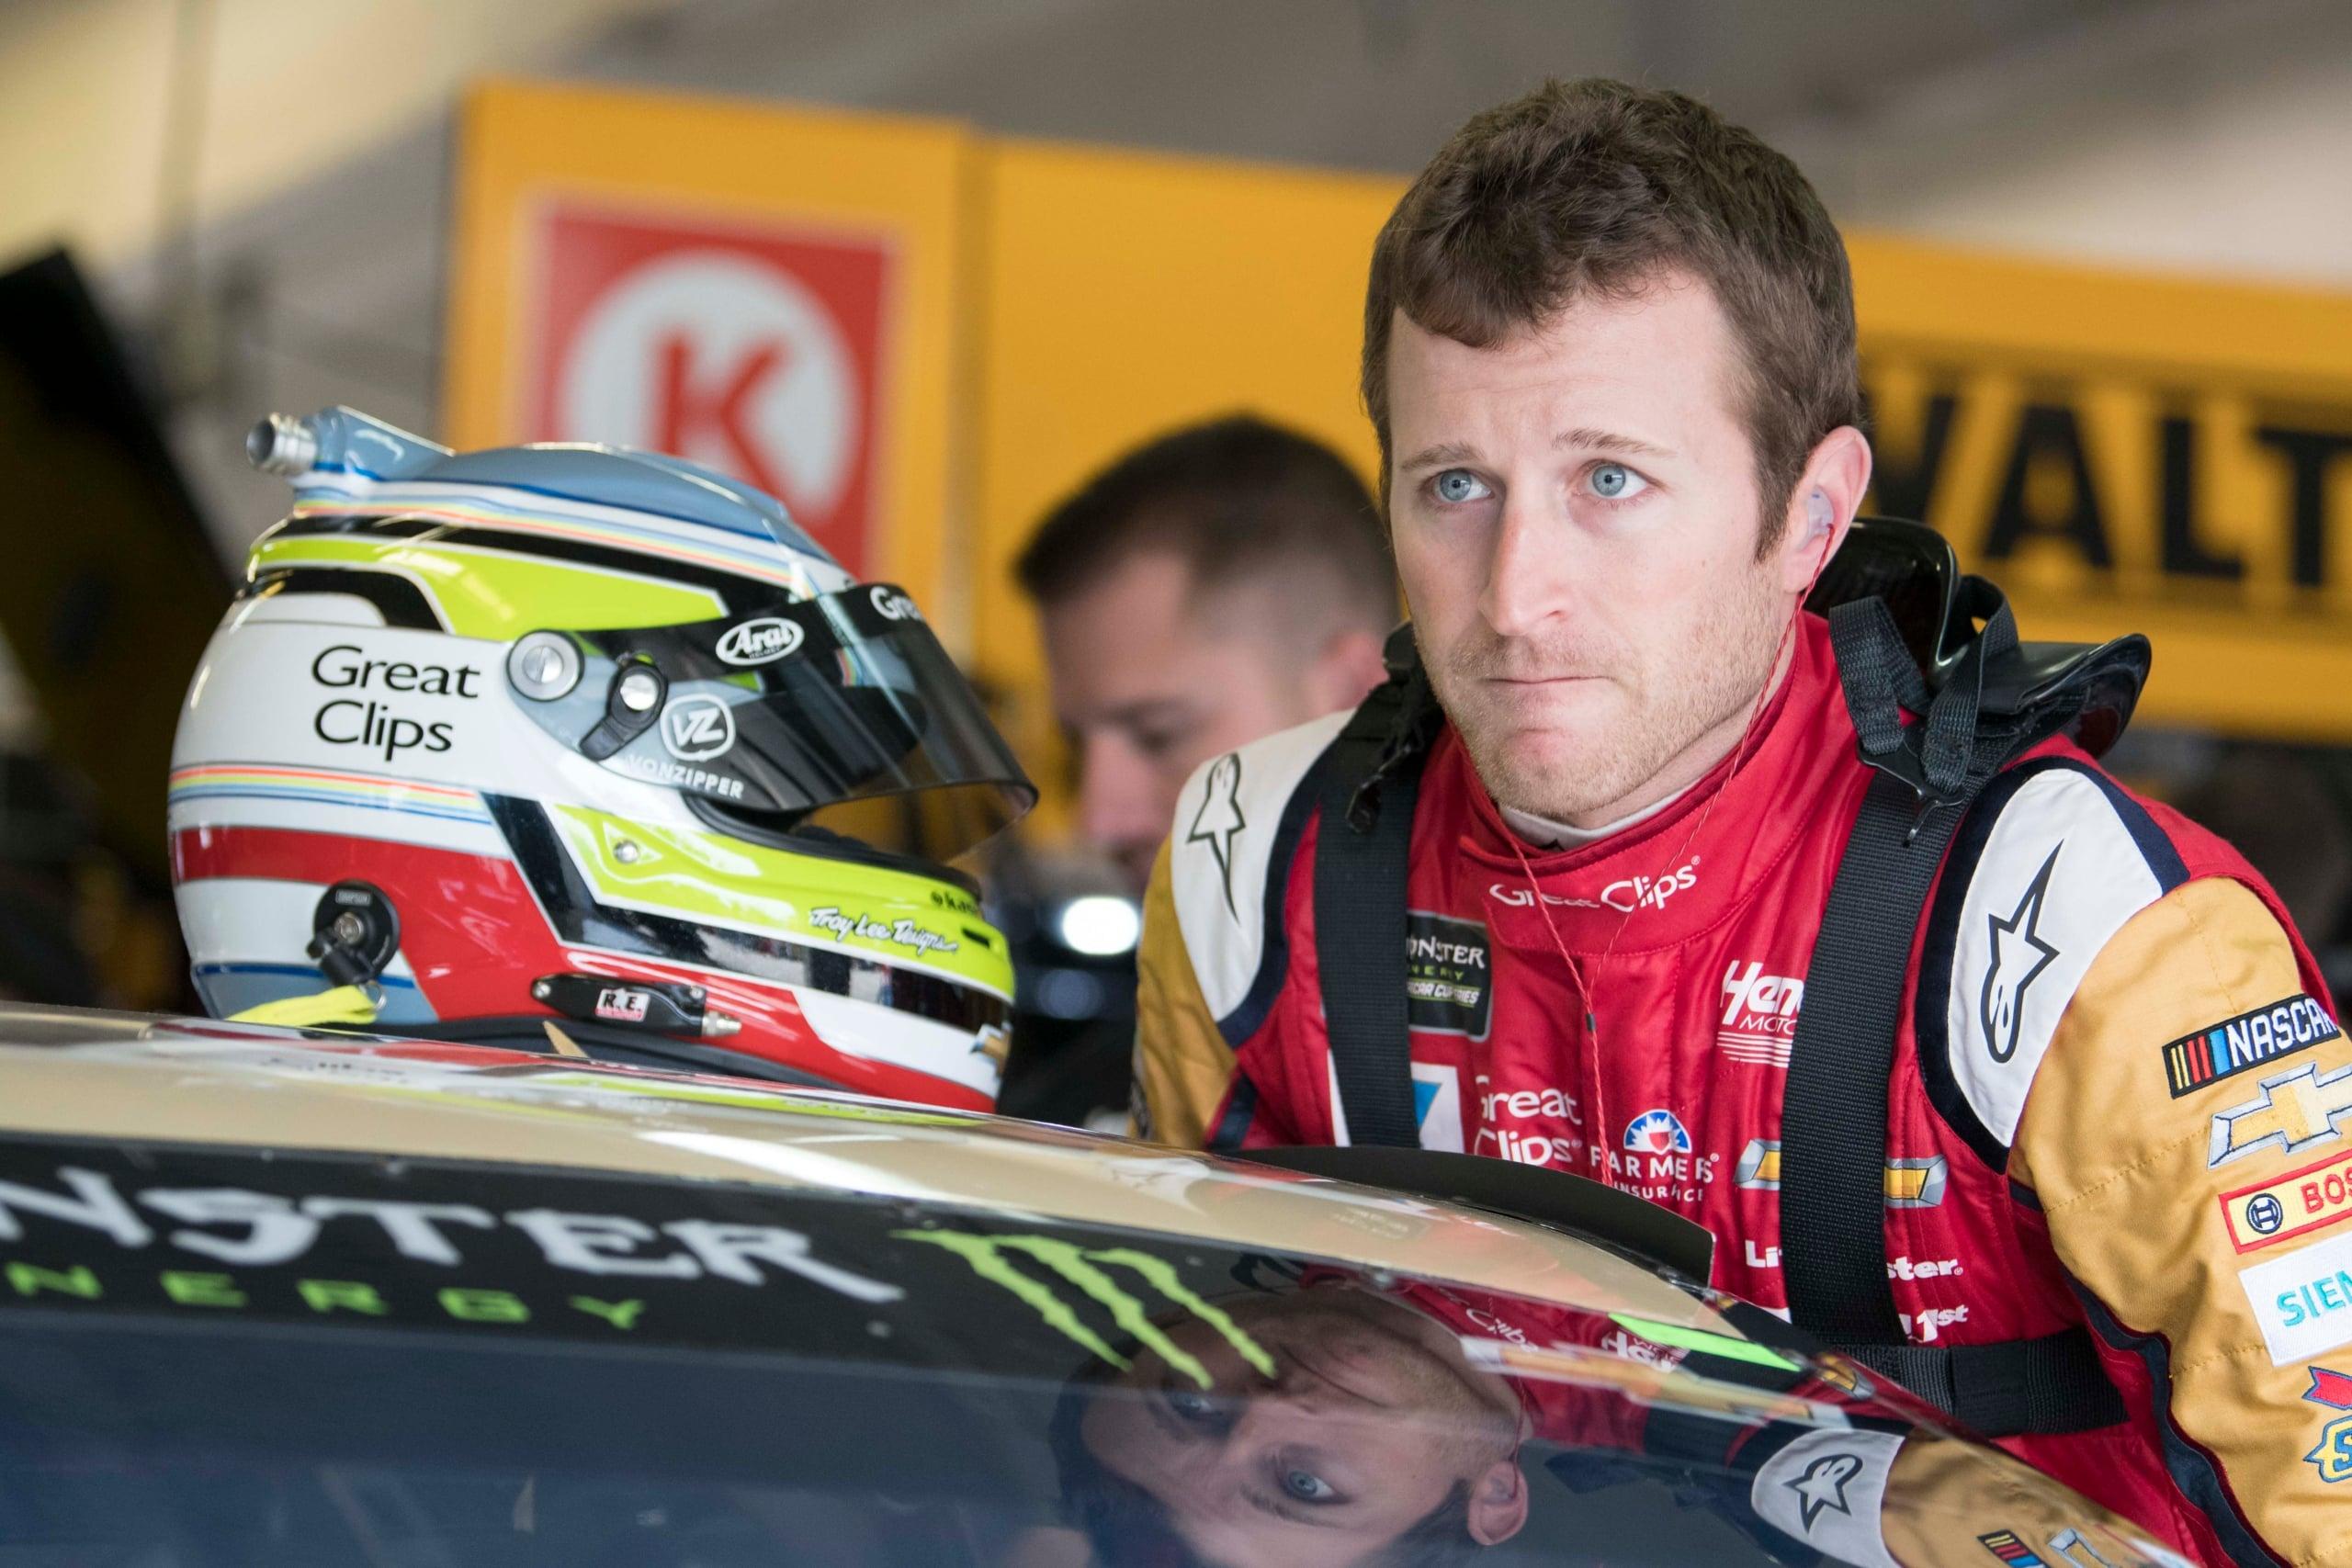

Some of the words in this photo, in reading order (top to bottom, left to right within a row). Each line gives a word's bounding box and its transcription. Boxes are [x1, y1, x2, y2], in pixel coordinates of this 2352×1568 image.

[654, 327, 818, 525] K
[726, 624, 794, 656] Arai
[311, 645, 481, 699] Great
[314, 699, 454, 762] Clips
[672, 706, 726, 747] VZ
[627, 754, 745, 800] VONZIPPER
[1600, 864, 1698, 912] Clips
[808, 907, 854, 942] Troy
[854, 913, 891, 940] Lee
[5, 1260, 645, 1330] NERGY
